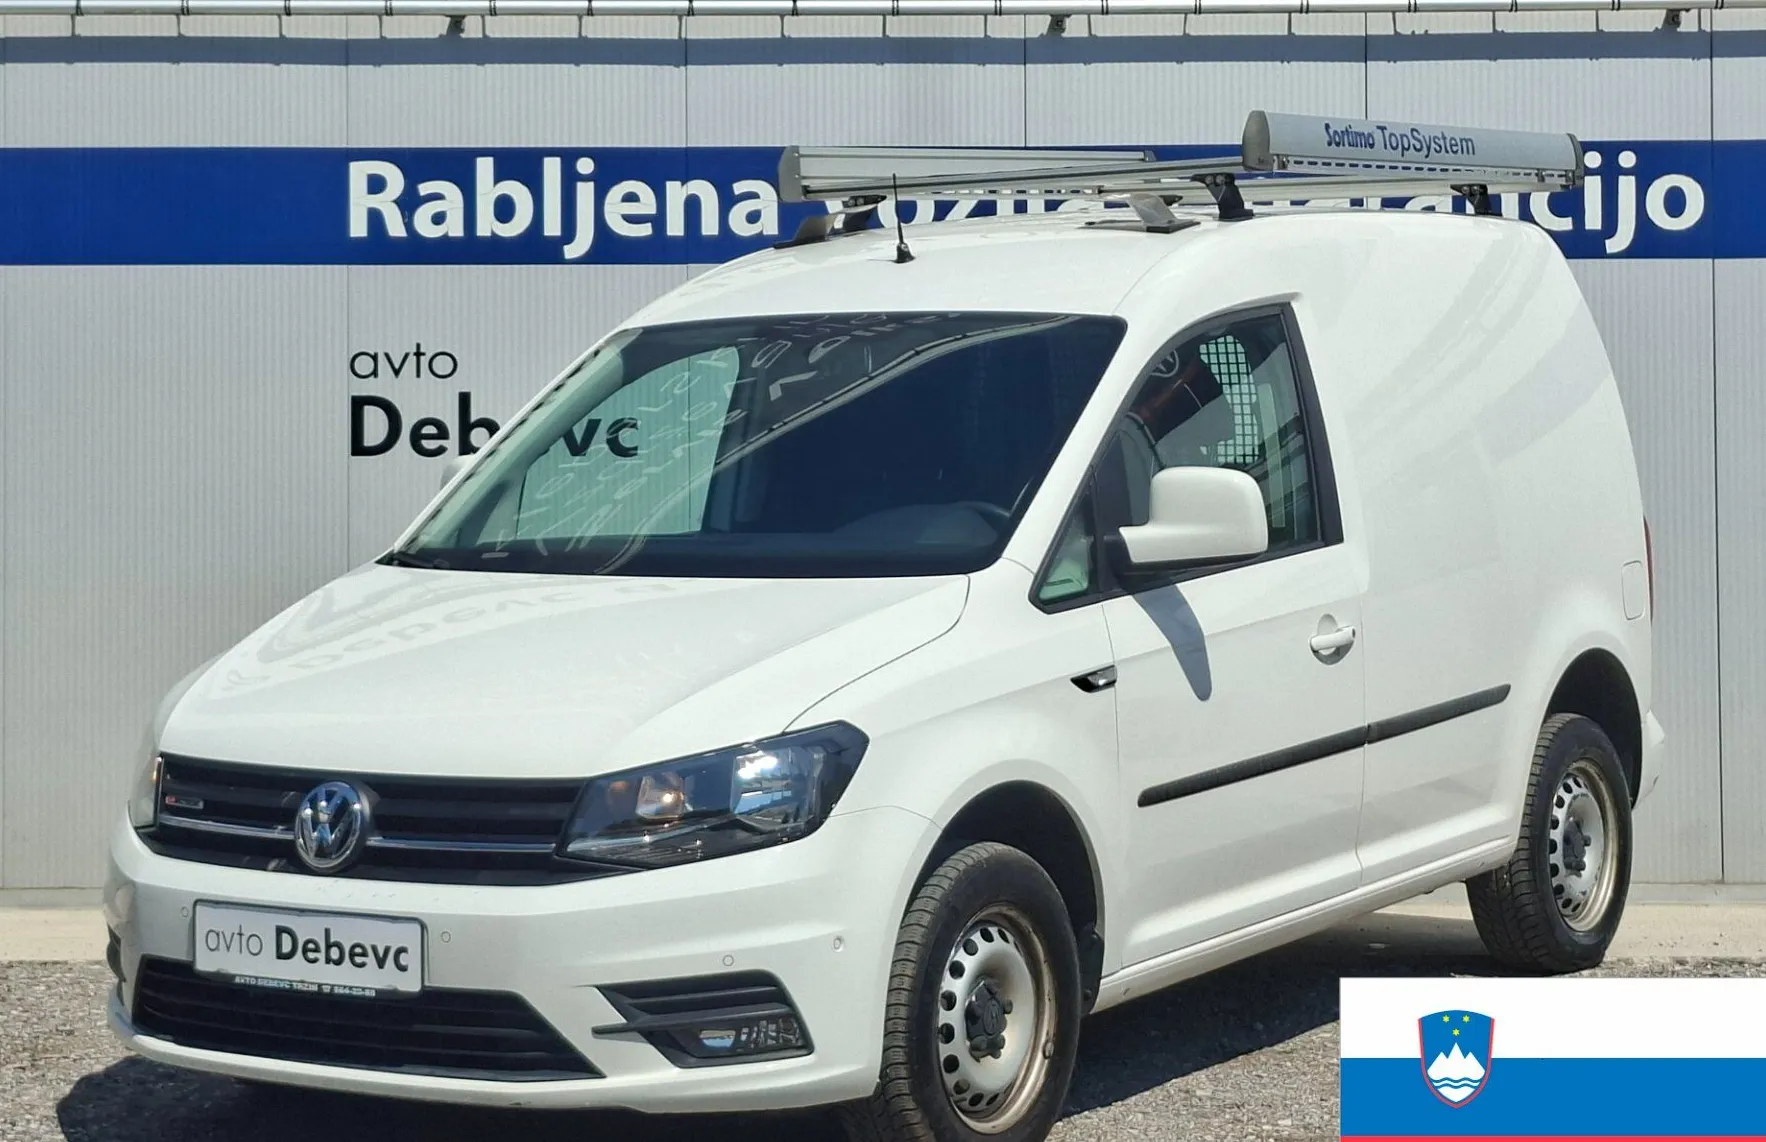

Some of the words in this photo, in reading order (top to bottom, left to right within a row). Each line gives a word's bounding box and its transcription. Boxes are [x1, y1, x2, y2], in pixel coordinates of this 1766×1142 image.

[1323, 122, 1376, 150] Sortimo
[1376, 124, 1476, 159] TopSystem
[348, 156, 779, 260] Rabljena
[349, 342, 459, 379] avto
[349, 391, 640, 458] Debvc
[205, 923, 264, 957] avto
[274, 924, 410, 972] Debevc
